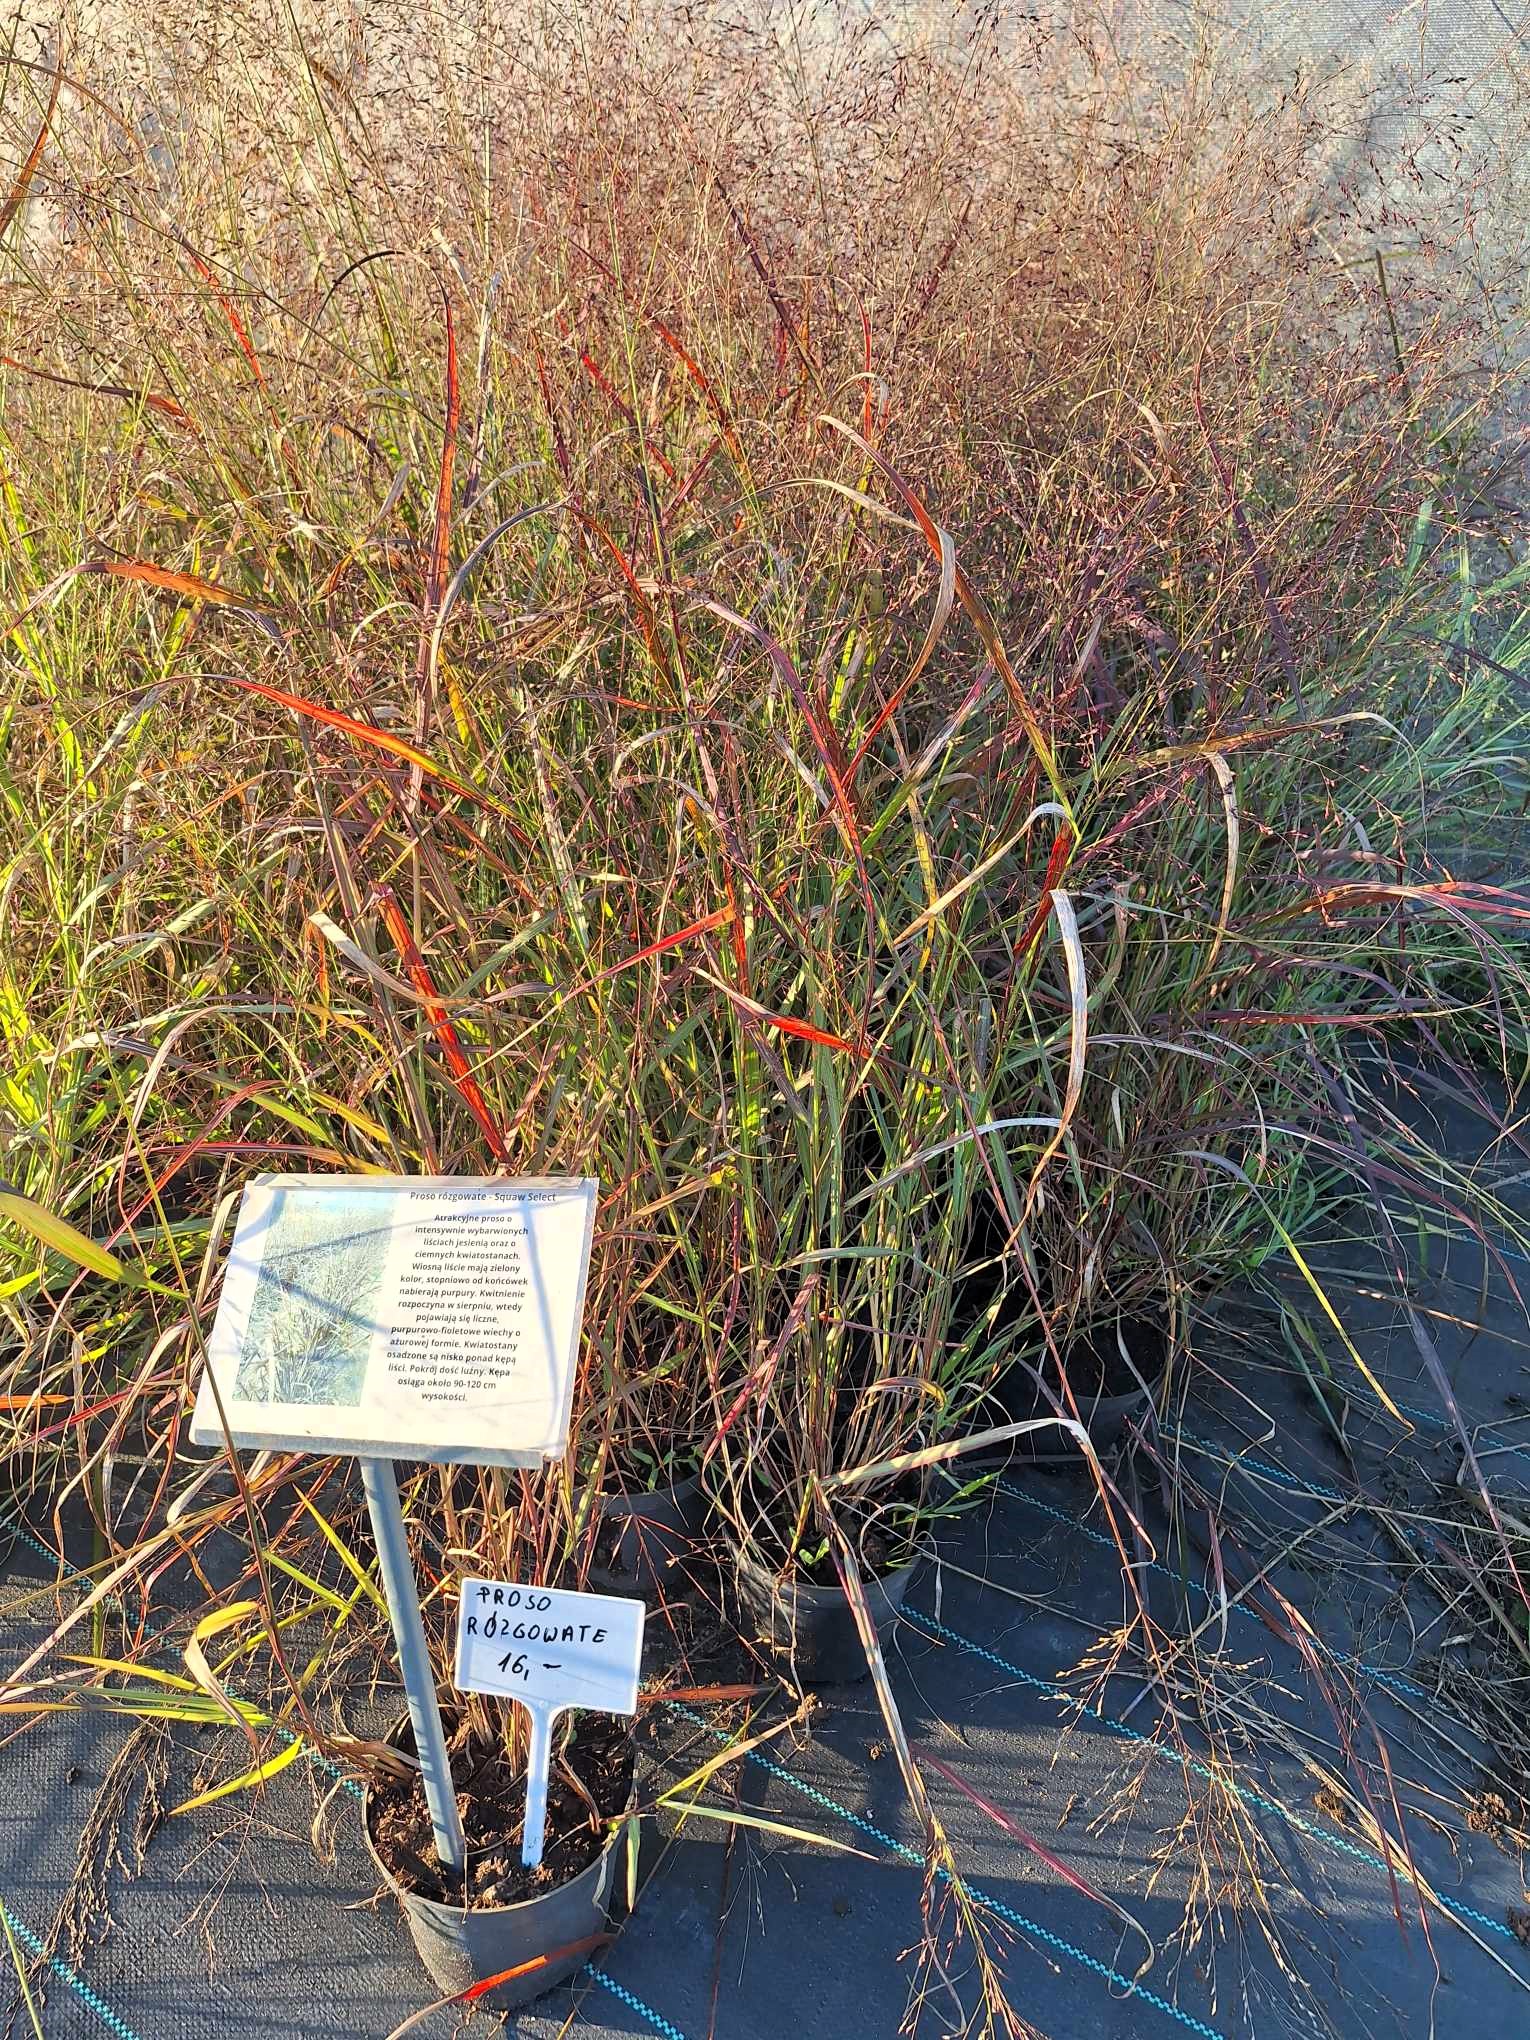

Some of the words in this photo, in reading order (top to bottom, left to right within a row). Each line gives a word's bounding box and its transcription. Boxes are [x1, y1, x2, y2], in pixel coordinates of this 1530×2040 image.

[410, 1191, 435, 1200] Proso
[495, 1192, 525, 1202] Squaw
[527, 1192, 556, 1202] Select
[434, 1214, 479, 1224] Atrakcyjne
[481, 1215, 504, 1224] proso
[415, 1226, 465, 1235] intensywnie
[467, 1227, 528, 1236] wybarwionych
[455, 1239, 488, 1248] jesienią
[414, 1250, 454, 1259] ciemnych
[456, 1251, 520, 1260] kwiatostanach.
[412, 1263, 442, 1272] Wiosną
[444, 1263, 465, 1271] liście
[467, 1264, 488, 1274] mają
[490, 1264, 520, 1274] zielony
[400, 1275, 424, 1284] kolor,
[427, 1276, 470, 1284] stopniowo
[472, 1276, 483, 1284] od
[485, 1276, 528, 1286] końcówek
[399, 1288, 438, 1298] nabierają
[441, 1290, 477, 1298] purpury.
[479, 1290, 525, 1298] Kwitnienie
[398, 1302, 445, 1310] rozpoczyna
[456, 1302, 494, 1311] sierpniu,
[496, 1303, 522, 1312] wtedy
[416, 1314, 456, 1323] pojawiają
[459, 1314, 471, 1324] się
[473, 1315, 499, 1324] liczne,
[390, 1325, 481, 1336] purpurowo-fioletowe
[483, 1328, 514, 1337] wiechy
[390, 1338, 429, 1348] ażurowej
[431, 1339, 462, 1348] formie.
[464, 1341, 518, 1350] Kwiatostany
[386, 1351, 427, 1360] osadzone
[429, 1353, 438, 1361] są
[441, 1353, 464, 1361] nisko
[466, 1354, 493, 1363] ponad
[495, 1354, 516, 1364] kępą
[409, 1365, 438, 1374] Pokrój
[439, 1365, 459, 1374] dość
[488, 1368, 510, 1378] Kępa
[398, 1377, 425, 1387] osiąga
[453, 1380, 481, 1389] 90-120
[421, 1392, 468, 1401] wysokości.
[476, 1586, 552, 1611] PROSO
[467, 1610, 608, 1643] RÓZGOWATE
